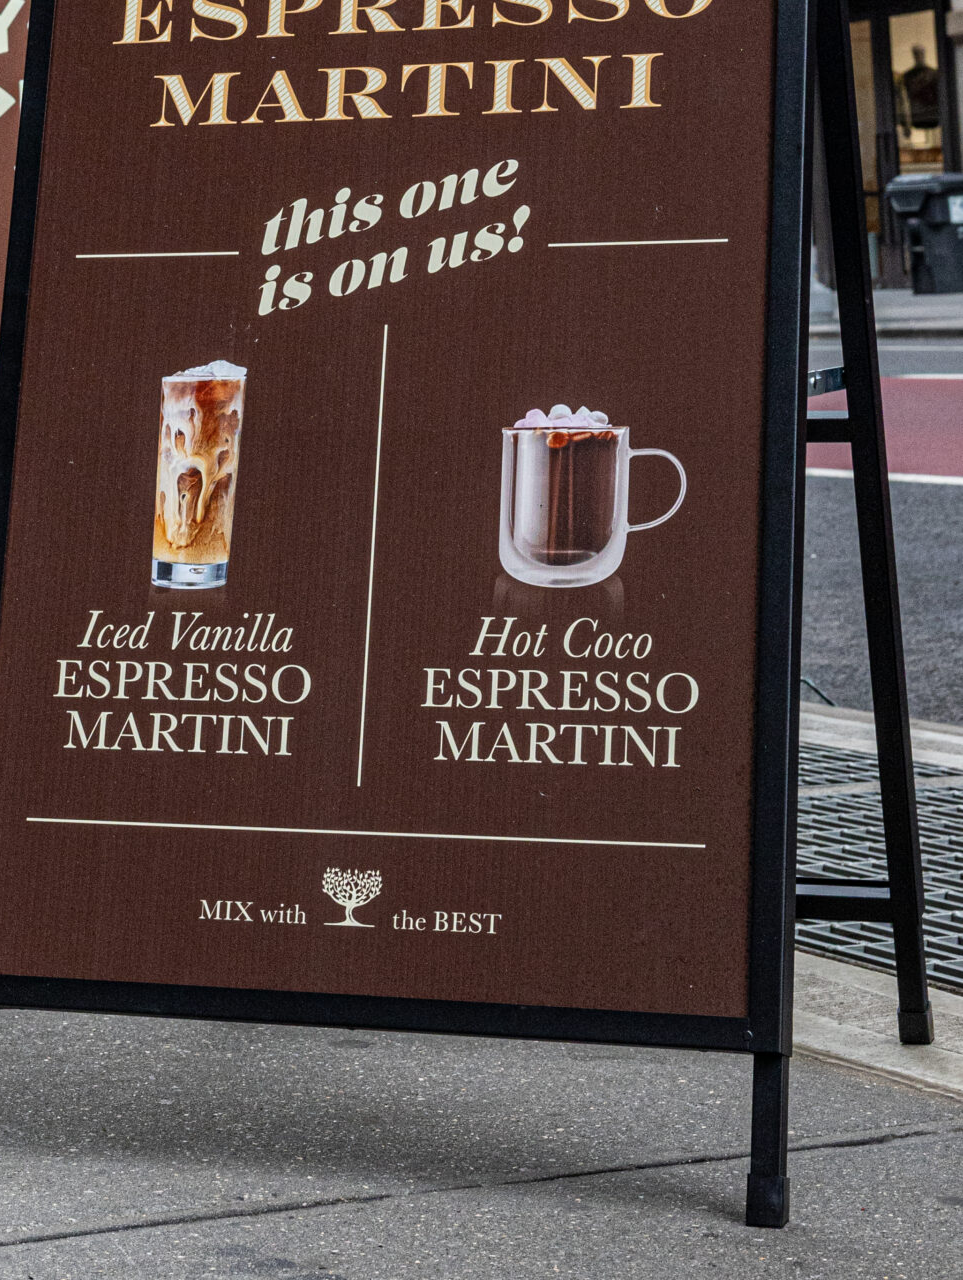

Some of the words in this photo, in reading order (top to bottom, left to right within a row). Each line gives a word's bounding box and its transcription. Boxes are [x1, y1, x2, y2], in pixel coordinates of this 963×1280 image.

[149, 52, 664, 128] MARTINI
[259, 186, 384, 257] this
[399, 158, 520, 219] one
[257, 264, 314, 317] is
[328, 237, 409, 298] on
[426, 204, 533, 277] us!
[77, 610, 155, 651] Iced
[170, 612, 294, 655] Vanilla
[469, 616, 548, 658] Hot
[562, 618, 654, 660] Coco
[52, 659, 312, 706] ESPRESSO
[420, 667, 700, 715] ESPRESSO
[63, 710, 295, 757] MARTINI
[433, 720, 683, 769] MARTINI
[199, 899, 253, 924] MIX
[260, 902, 308, 926] with
[392, 907, 429, 932] the
[433, 911, 503, 936] BEST
